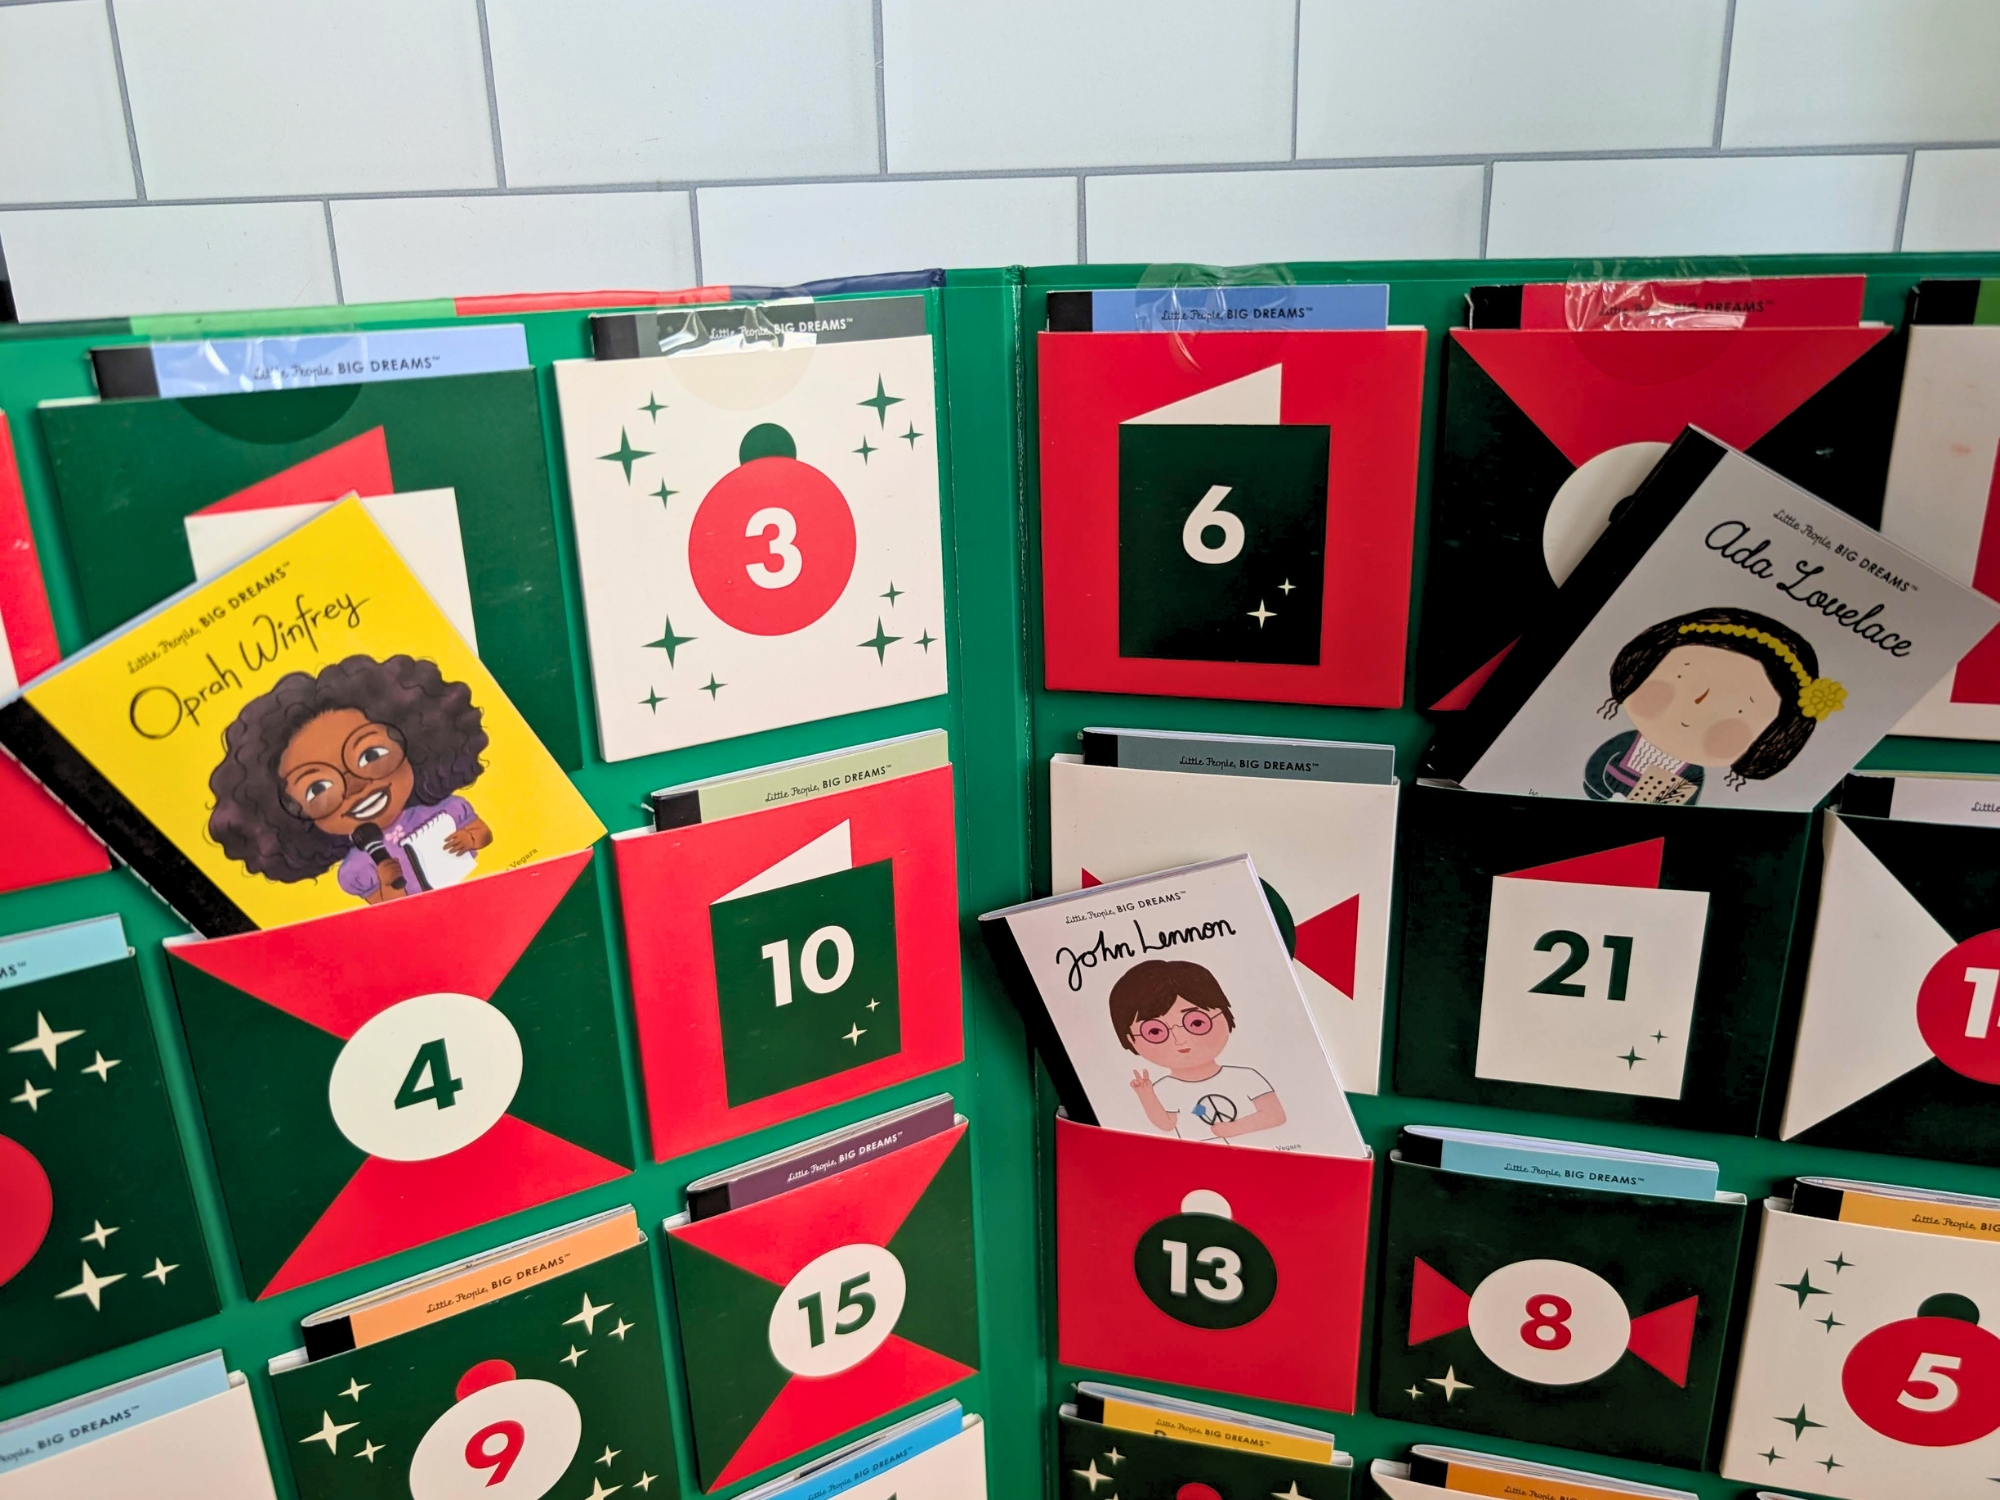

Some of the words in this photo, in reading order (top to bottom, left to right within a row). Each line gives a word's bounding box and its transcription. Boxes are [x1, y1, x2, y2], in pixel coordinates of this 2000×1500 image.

[773, 322, 795, 335] BIG
[1226, 309, 1248, 320] BIG
[338, 360, 364, 374] BIG
[745, 507, 803, 590] 3
[1182, 485, 1245, 564] 6
[1773, 509, 1800, 530] Little
[1834, 544, 1859, 562] BIG
[1704, 520, 1774, 579] Ada
[1776, 560, 1913, 658] Lovelace
[127, 650, 161, 675] Little
[200, 606, 226, 629] BIG
[129, 653, 243, 740] Oprah
[238, 594, 371, 672] Winfrey
[1179, 755, 1204, 766] Little
[1239, 759, 1260, 769] BIG
[765, 792, 789, 802] Little
[822, 777, 841, 789] BIG
[509, 849, 538, 868] Vegara
[1065, 914, 1087, 925] Little
[1116, 902, 1135, 913] BIG
[761, 925, 855, 1008] 10
[1055, 930, 1136, 992] John
[1133, 919, 1237, 954] Lennon
[1527, 929, 1634, 1001] 21
[1964, 967, 2000, 1039] 1
[394, 1037, 463, 1110] 4
[787, 1169, 810, 1182] Little
[839, 1149, 856, 1163] BIG
[1504, 1163, 1529, 1173] Little
[1564, 1169, 1584, 1179] BIG
[1911, 1214, 1940, 1225] Little
[426, 1299, 454, 1314] Little
[491, 1275, 512, 1290] BIG
[1162, 1239, 1244, 1301] 13
[798, 1270, 876, 1349] 15
[1520, 1294, 1572, 1350] 8
[1896, 1352, 1962, 1412] 5
[37, 1433, 65, 1449] BIG
[465, 1420, 525, 1488] 9
[1204, 1429, 1222, 1438] BIG
[854, 1468, 870, 1480] BIG
